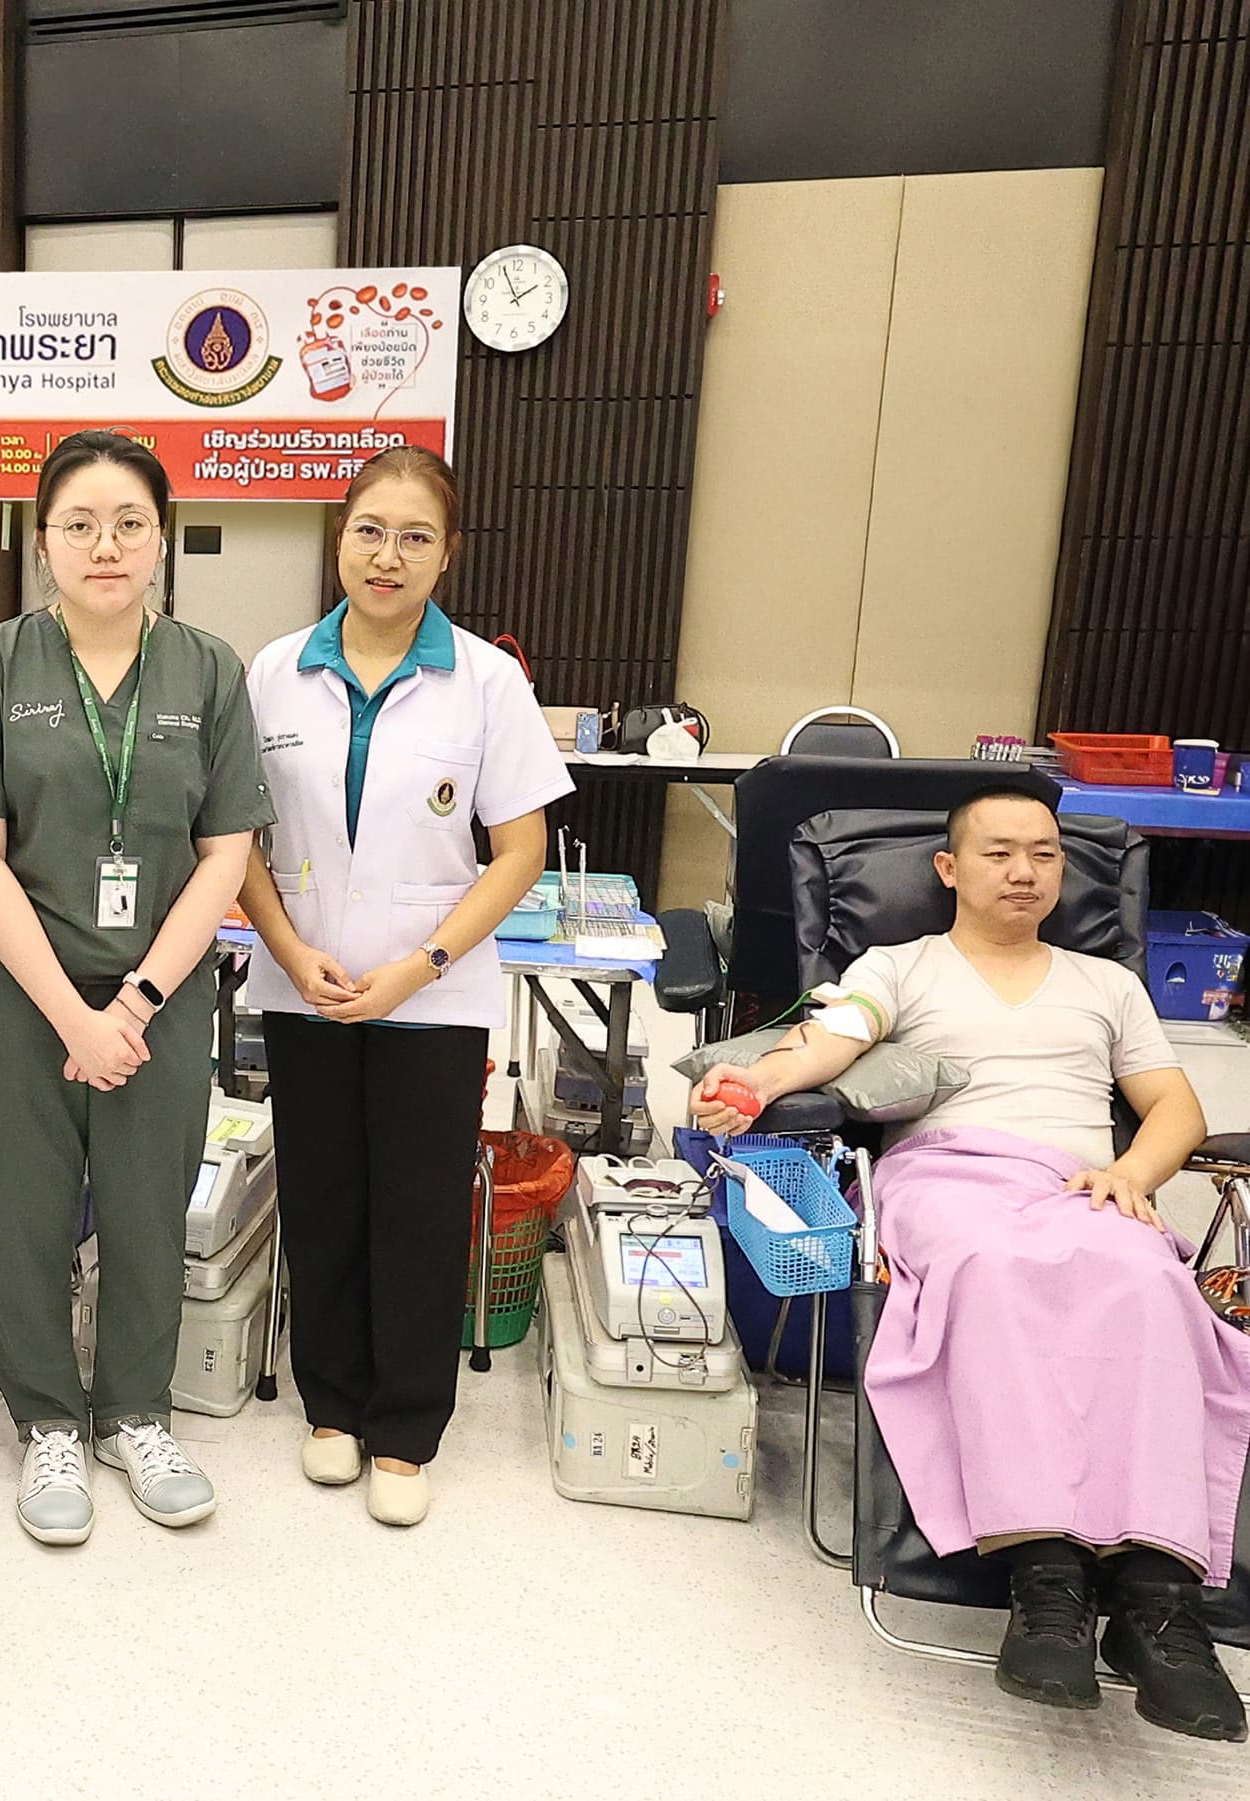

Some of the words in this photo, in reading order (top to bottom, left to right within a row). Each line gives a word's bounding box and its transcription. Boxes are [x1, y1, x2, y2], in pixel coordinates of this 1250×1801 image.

[512, 259, 524, 272] 12
[484, 277, 495, 290] 10
[544, 275, 553, 288] 2
[479, 294, 488, 306] 9
[545, 292, 553, 304] 3
[19, 305, 118, 327] โรงพยาบาล
[481, 310, 489, 322] 8
[495, 323, 503, 335] 7
[510, 327, 518, 339] 6
[527, 321, 536, 333] 5
[41, 372, 116, 391] Hospital
[1, 449, 32, 460] 10.00
[194, 450, 294, 485] เพื่อผู้ป่วย
[9, 699, 65, 728] Siriraj
